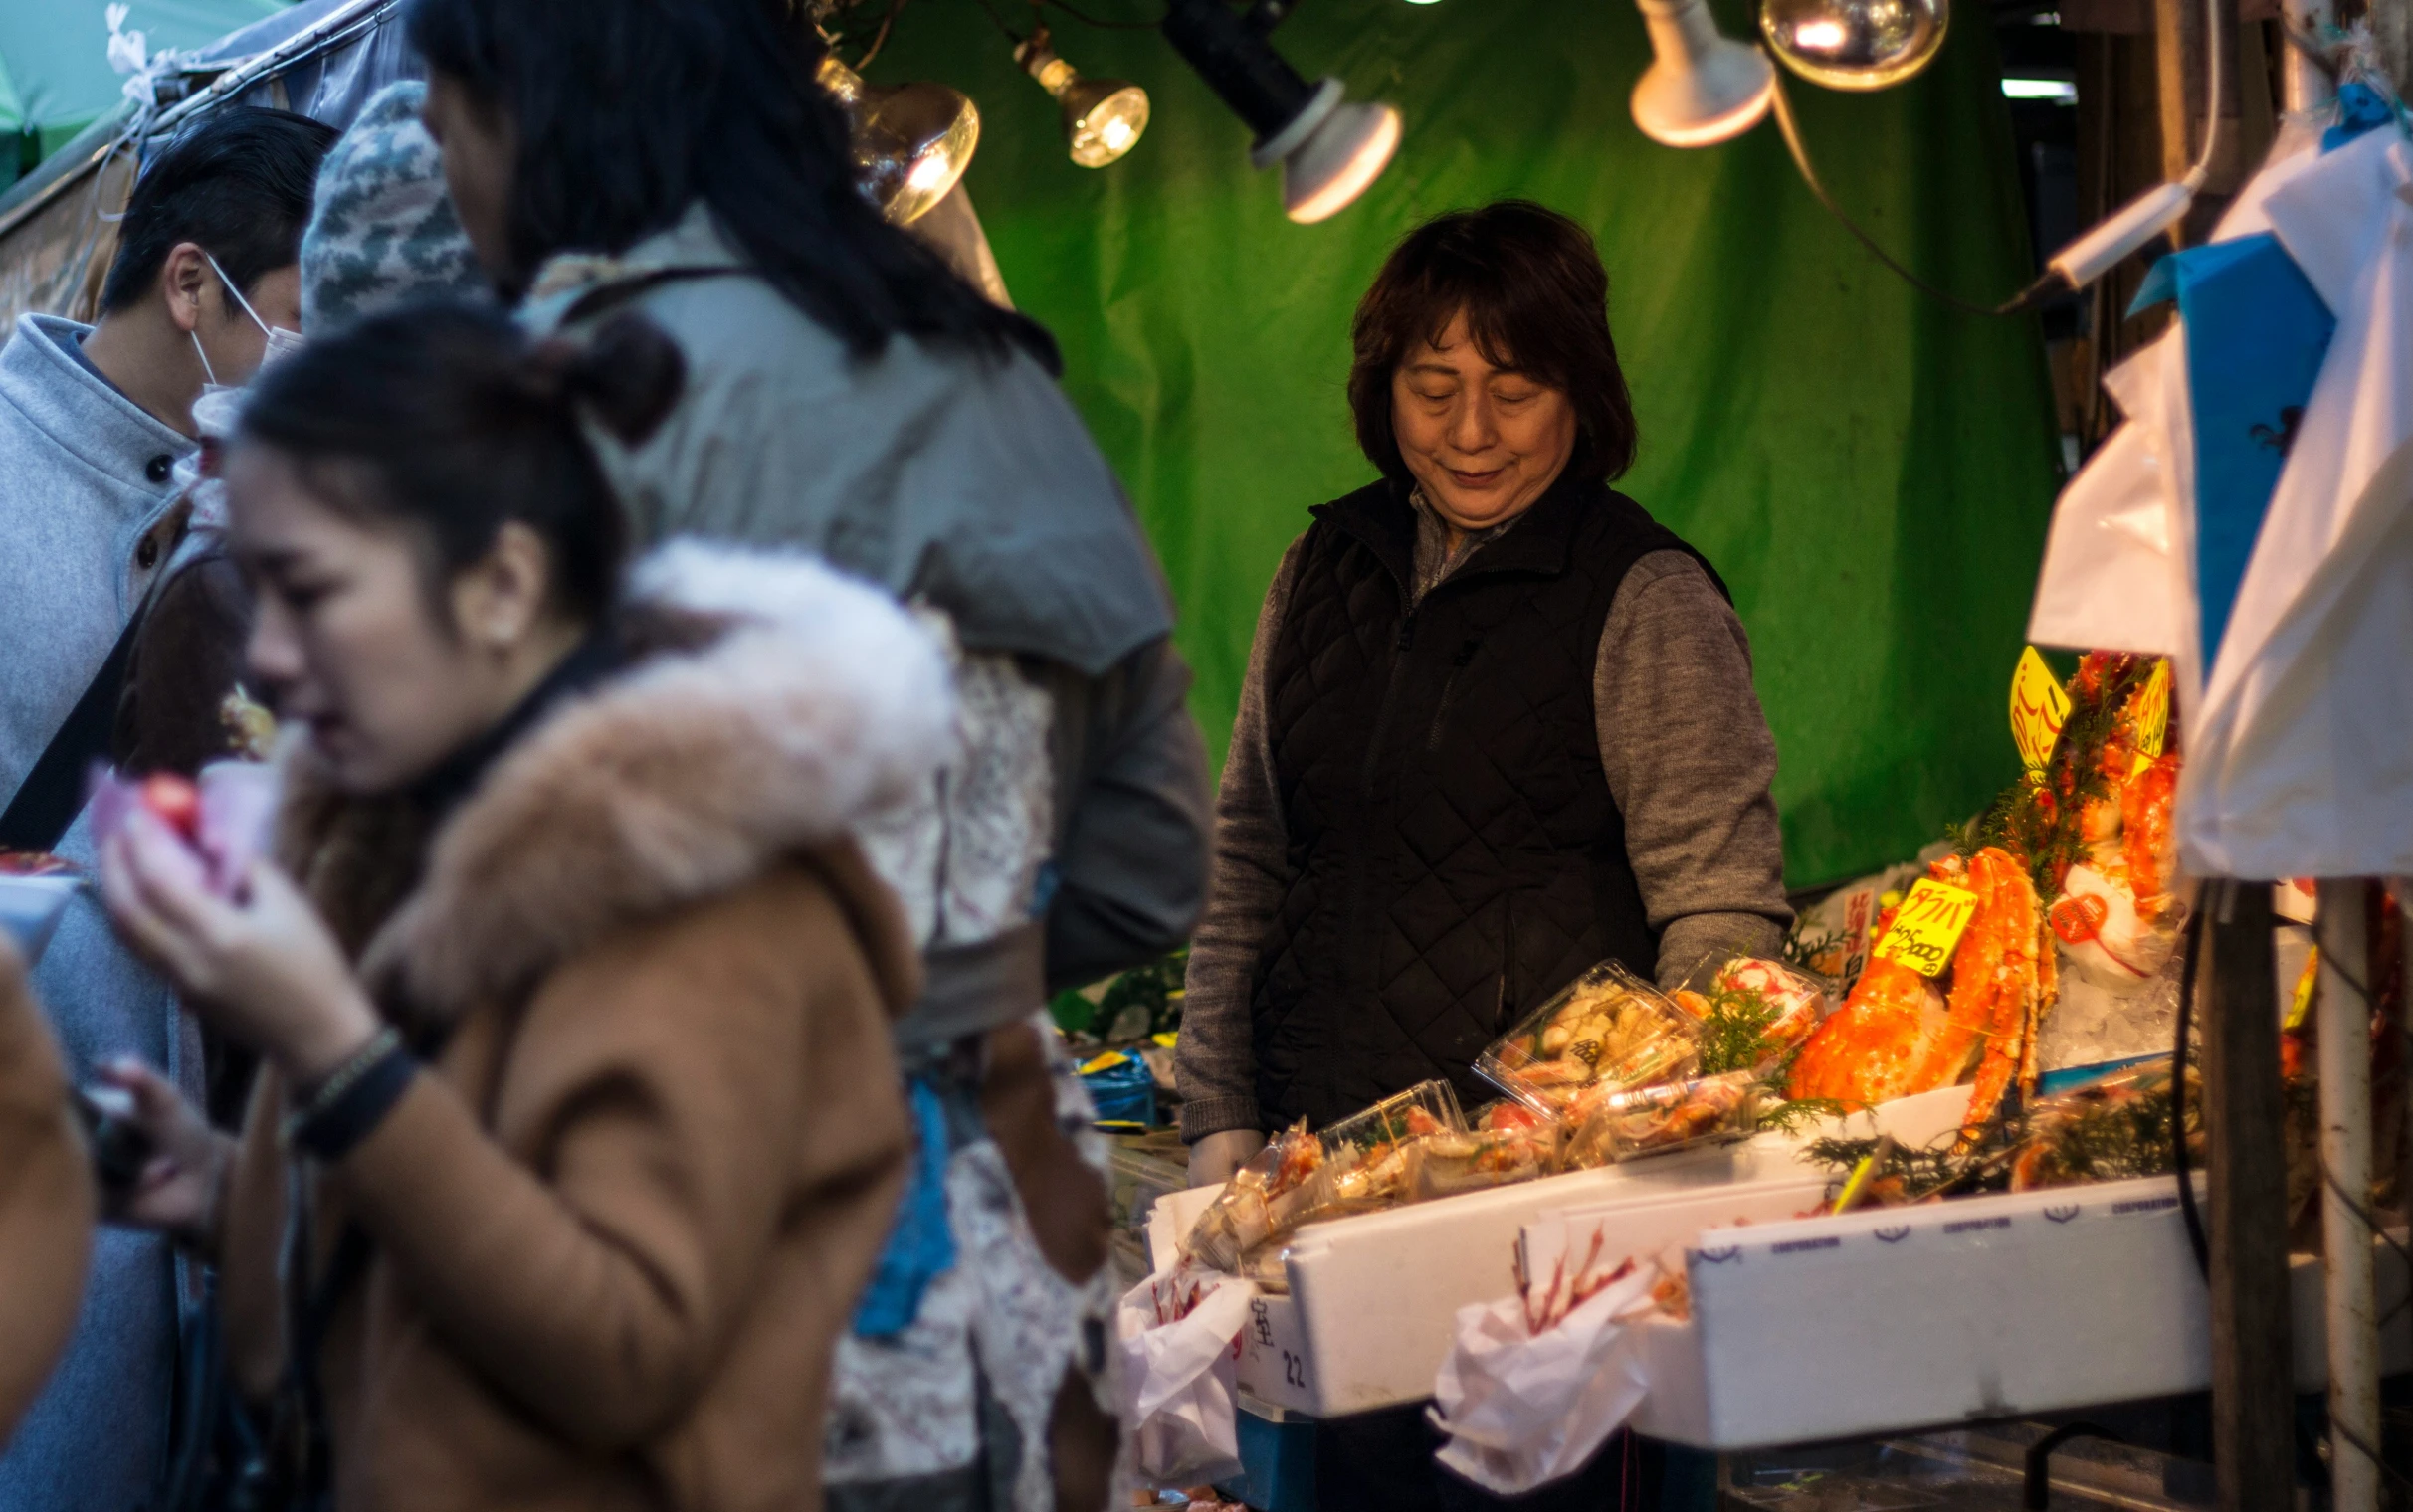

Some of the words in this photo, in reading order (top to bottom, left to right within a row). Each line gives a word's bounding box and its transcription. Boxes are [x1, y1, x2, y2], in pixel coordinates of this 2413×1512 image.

[1900, 888, 1977, 930] タラバ
[2111, 1197, 2179, 1214] CORPORATION
[1943, 1217, 2011, 1233] CORPORATION
[1771, 1236, 1840, 1254] CORPORATION
[1282, 1348, 1307, 1389] 22
